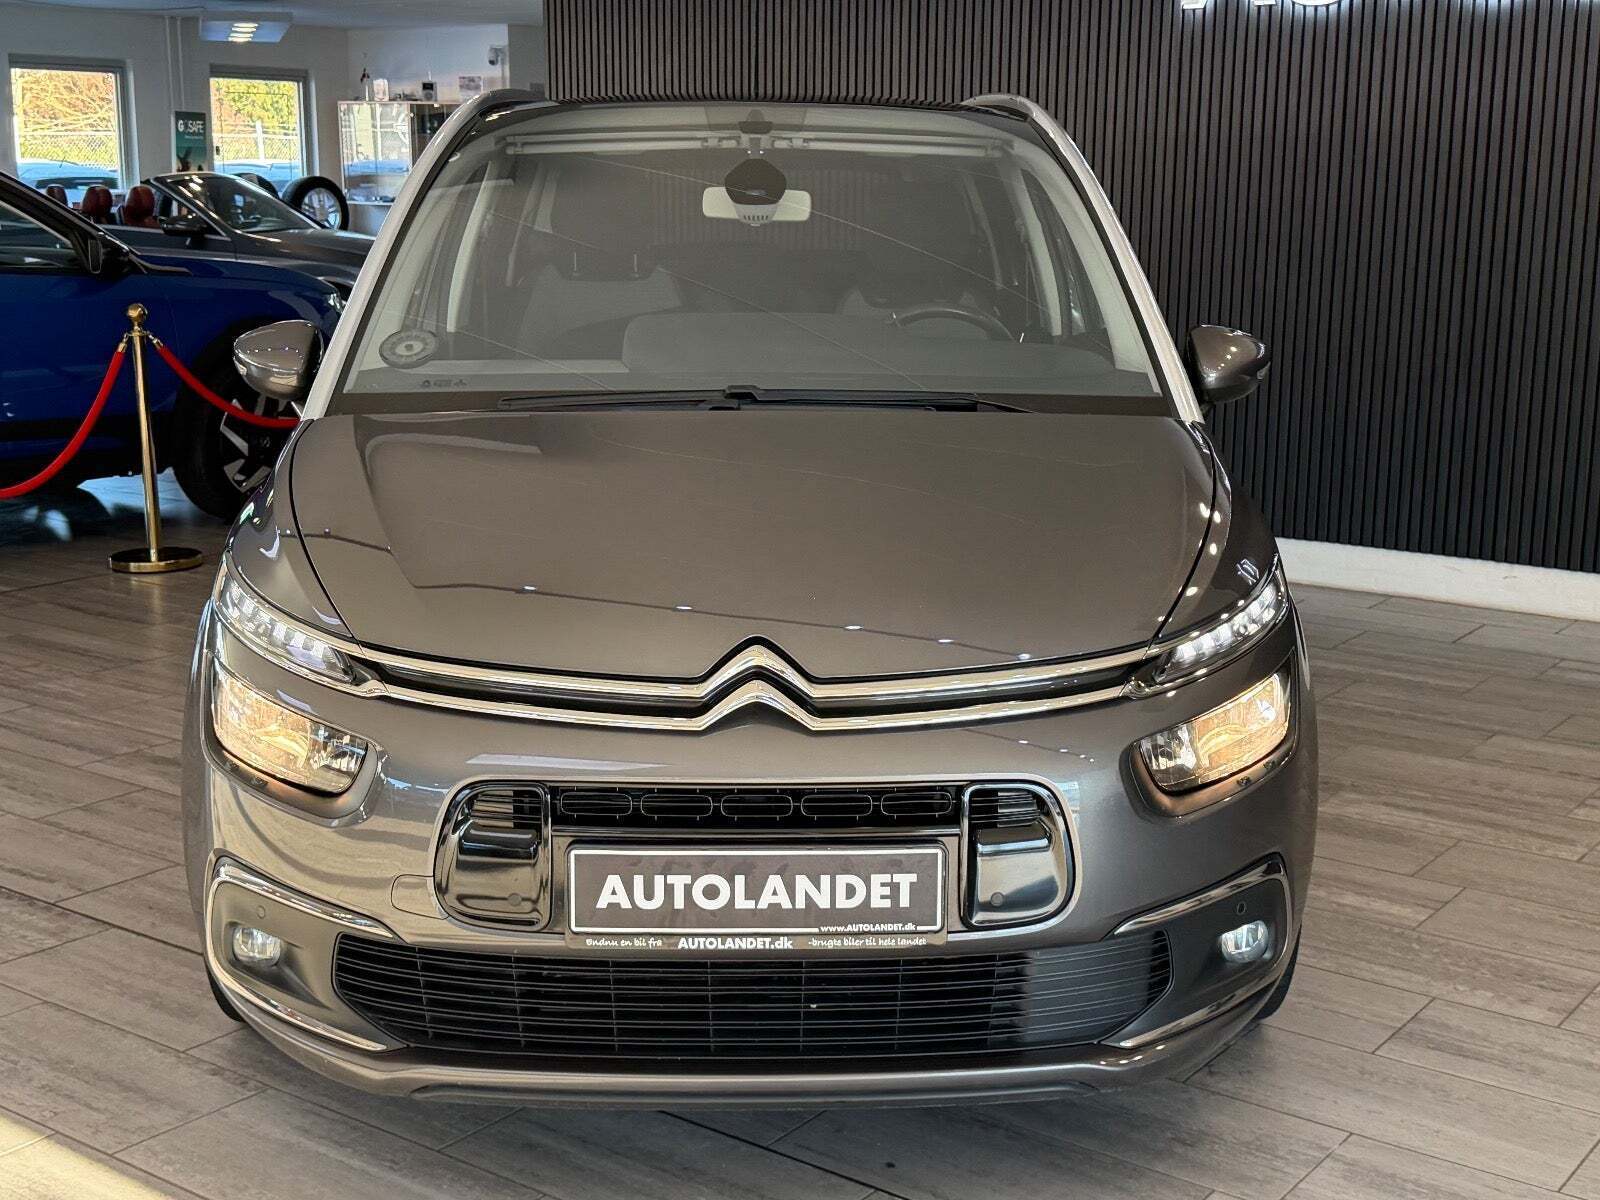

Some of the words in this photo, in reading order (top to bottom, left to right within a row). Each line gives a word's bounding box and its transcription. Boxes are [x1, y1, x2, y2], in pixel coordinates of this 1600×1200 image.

[595, 873, 918, 910] AUTOLANDET
[820, 923, 916, 932] www.AUTOLANDET.dk
[634, 937, 647, 946] bil
[648, 937, 663, 949] fra
[677, 937, 794, 949] AUTOLANDET.dk
[843, 937, 864, 946] biler
[866, 937, 877, 946] til
[878, 937, 896, 946] hele
[897, 937, 928, 946] landet
